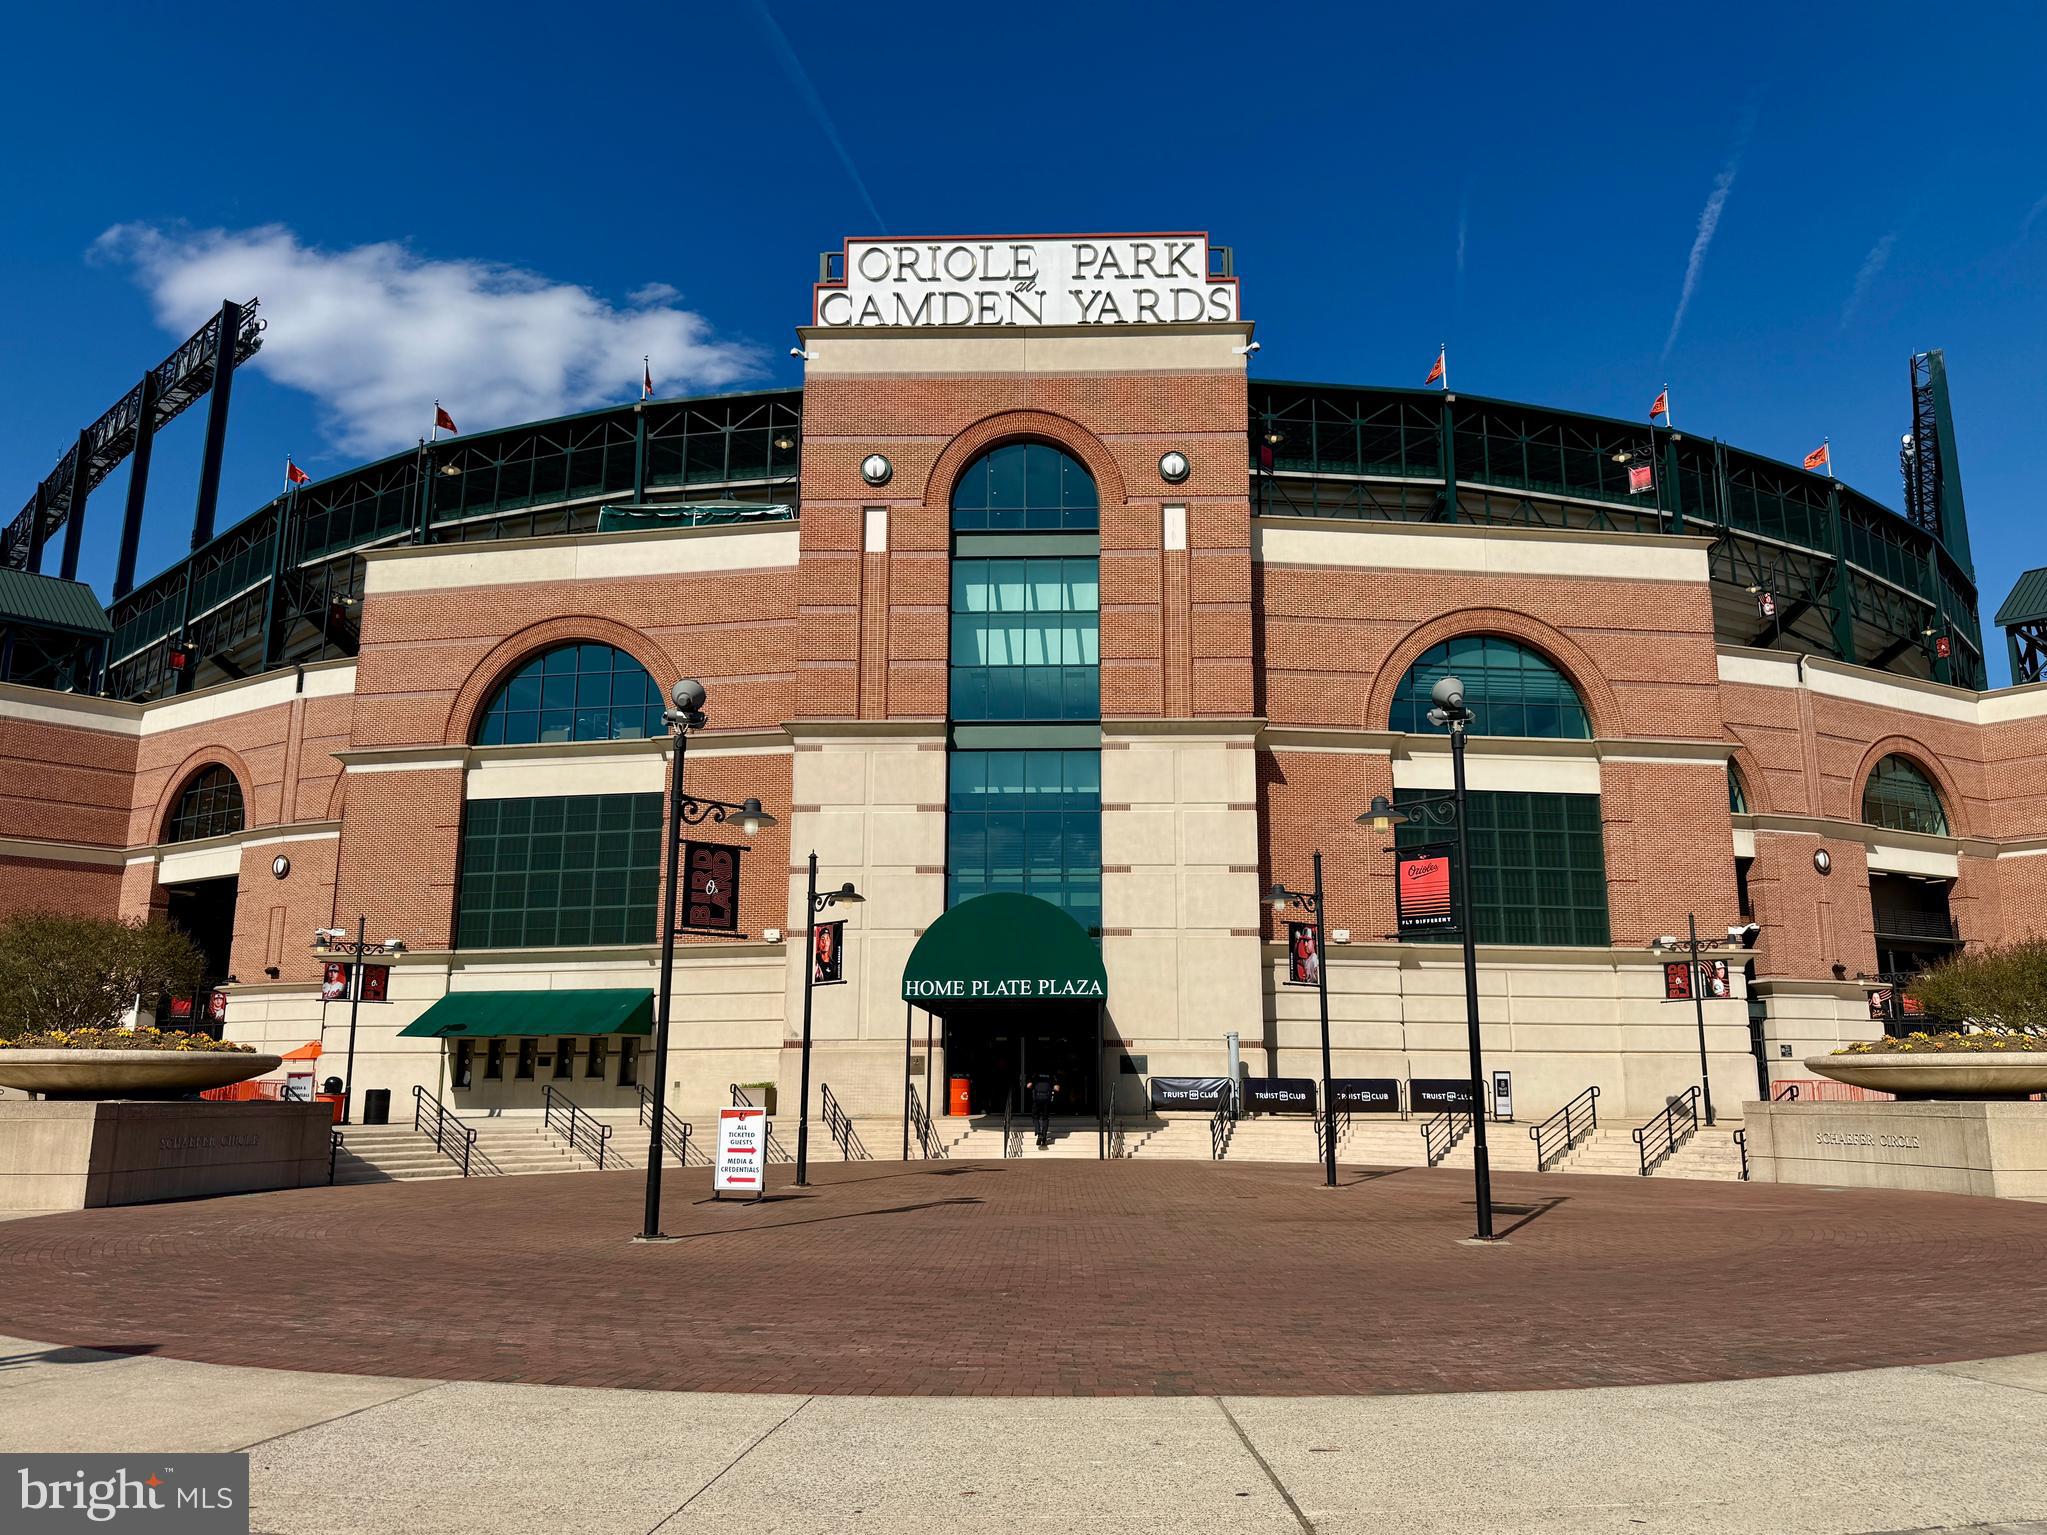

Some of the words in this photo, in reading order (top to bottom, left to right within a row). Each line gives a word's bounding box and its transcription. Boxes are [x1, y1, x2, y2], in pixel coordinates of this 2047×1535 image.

[857, 244, 1039, 282] ORIOLE
[1071, 242, 1199, 280] PARK
[1014, 281, 1037, 293] at
[819, 290, 1047, 327] CAMDEN
[1068, 287, 1233, 325] YARDS
[1408, 862, 1440, 879] Orioles
[690, 850, 713, 925] BIRD
[710, 851, 733, 927] LAND
[1415, 916, 1452, 924] DIFFERENT
[905, 980, 965, 996] HOME
[971, 979, 1032, 996] PLATE
[1038, 979, 1104, 995] PLAZA
[1422, 1092, 1446, 1100] TRUIST
[1816, 1132, 1875, 1146] SCHAEFER
[1880, 1135, 1920, 1148] CIRCLE
